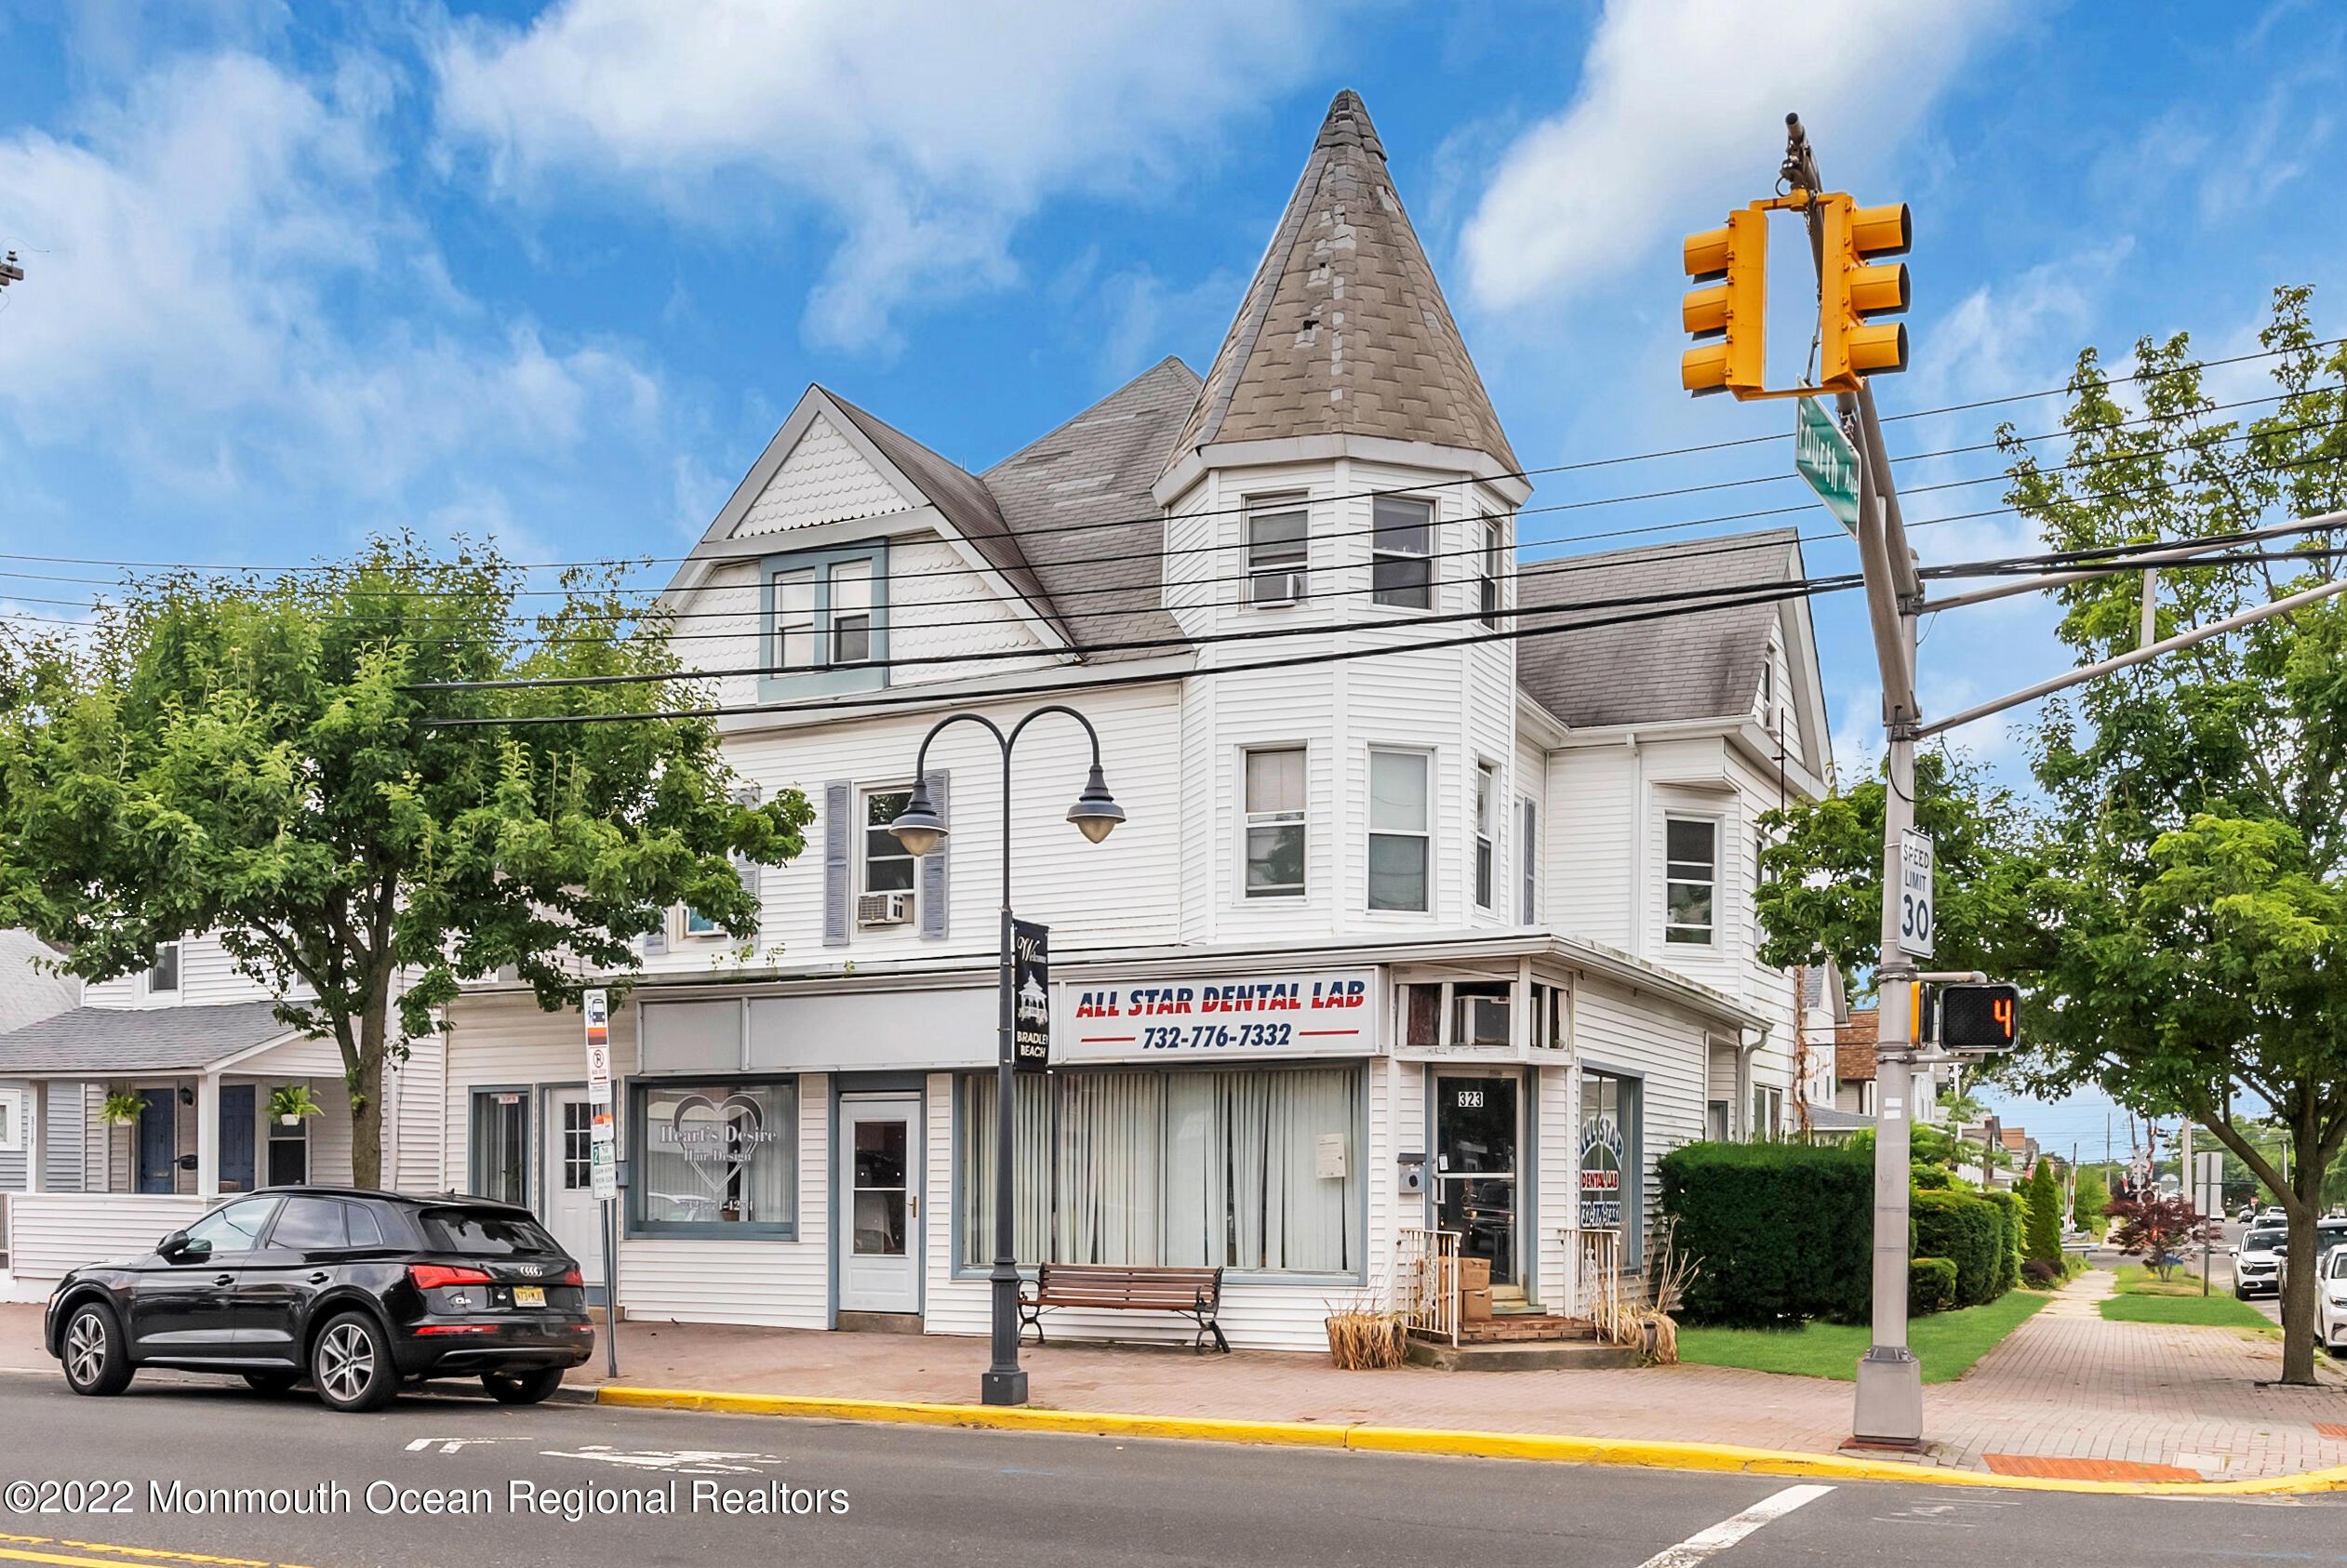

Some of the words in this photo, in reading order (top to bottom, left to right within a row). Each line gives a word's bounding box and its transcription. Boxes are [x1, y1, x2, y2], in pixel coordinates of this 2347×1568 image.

[1798, 404, 1838, 492] Fourth
[1902, 843, 1930, 870] SPEED
[1904, 870, 1927, 892] LIMIT
[1901, 893, 1929, 942] 30
[1075, 991, 1120, 1018] ALL
[1127, 988, 1194, 1017] STAR
[1201, 983, 1302, 1013] DENTAL
[1311, 981, 1366, 1010] LAB
[1994, 998, 2012, 1039] 4
[1142, 1023, 1292, 1050] 732-776-7332
[1020, 1044, 1047, 1058] BEACH
[1460, 1092, 1483, 1107] 323
[660, 1124, 720, 1144] Heart's
[723, 1124, 778, 1144] Desire
[1598, 1117, 1622, 1166] STAR
[684, 1149, 709, 1163] Hair
[713, 1149, 753, 1163] Design
[1582, 1172, 1606, 1189] DENTAL
[1607, 1171, 1619, 1189] LAB
